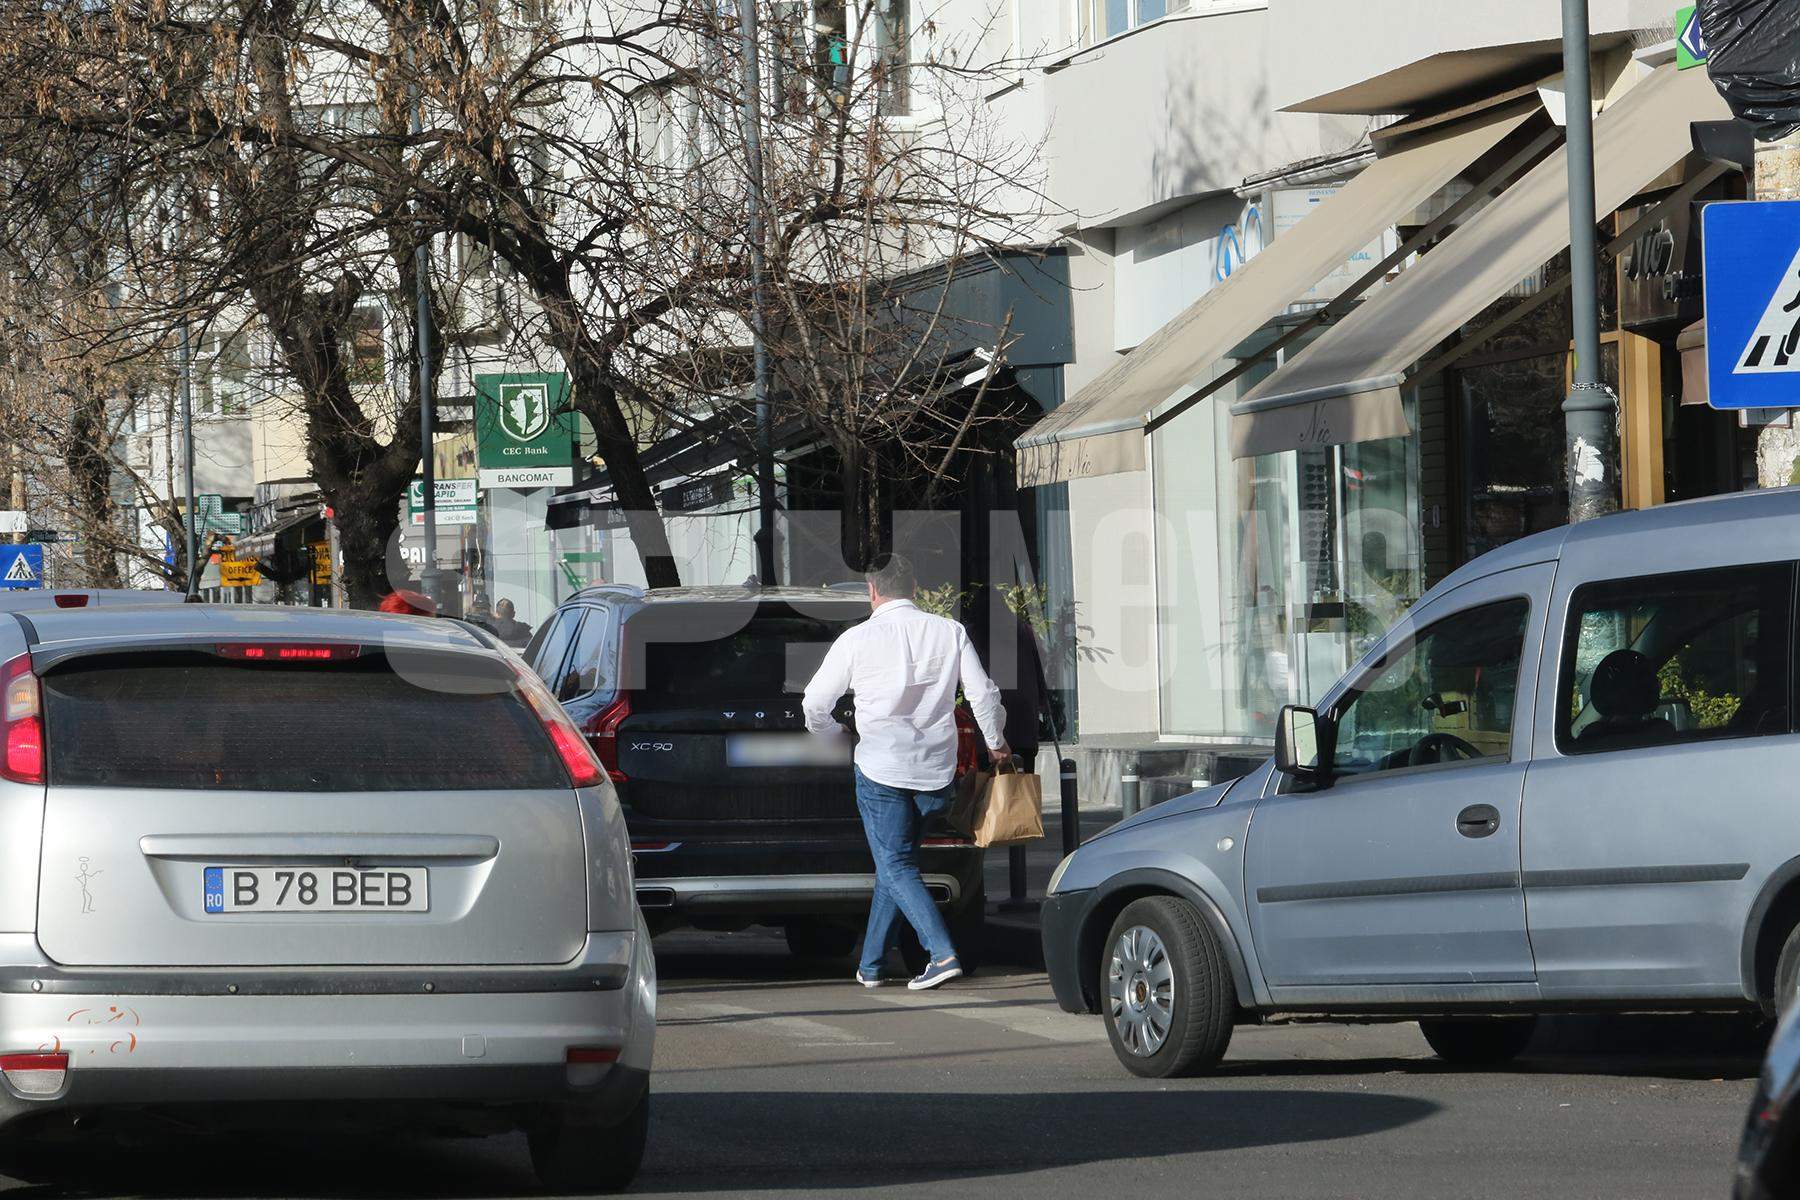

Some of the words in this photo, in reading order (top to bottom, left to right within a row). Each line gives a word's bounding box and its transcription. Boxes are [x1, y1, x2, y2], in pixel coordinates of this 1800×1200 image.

[503, 447, 522, 455] CEC
[524, 446, 548, 455] Bank
[497, 472, 555, 483] BANCOMAT
[434, 482, 473, 491] RANSFER
[434, 490, 456, 498] APID
[722, 710, 853, 719] VOLO
[233, 871, 259, 906] B
[273, 871, 318, 906] 78
[332, 871, 412, 906] BEB
[206, 893, 222, 908] RO
